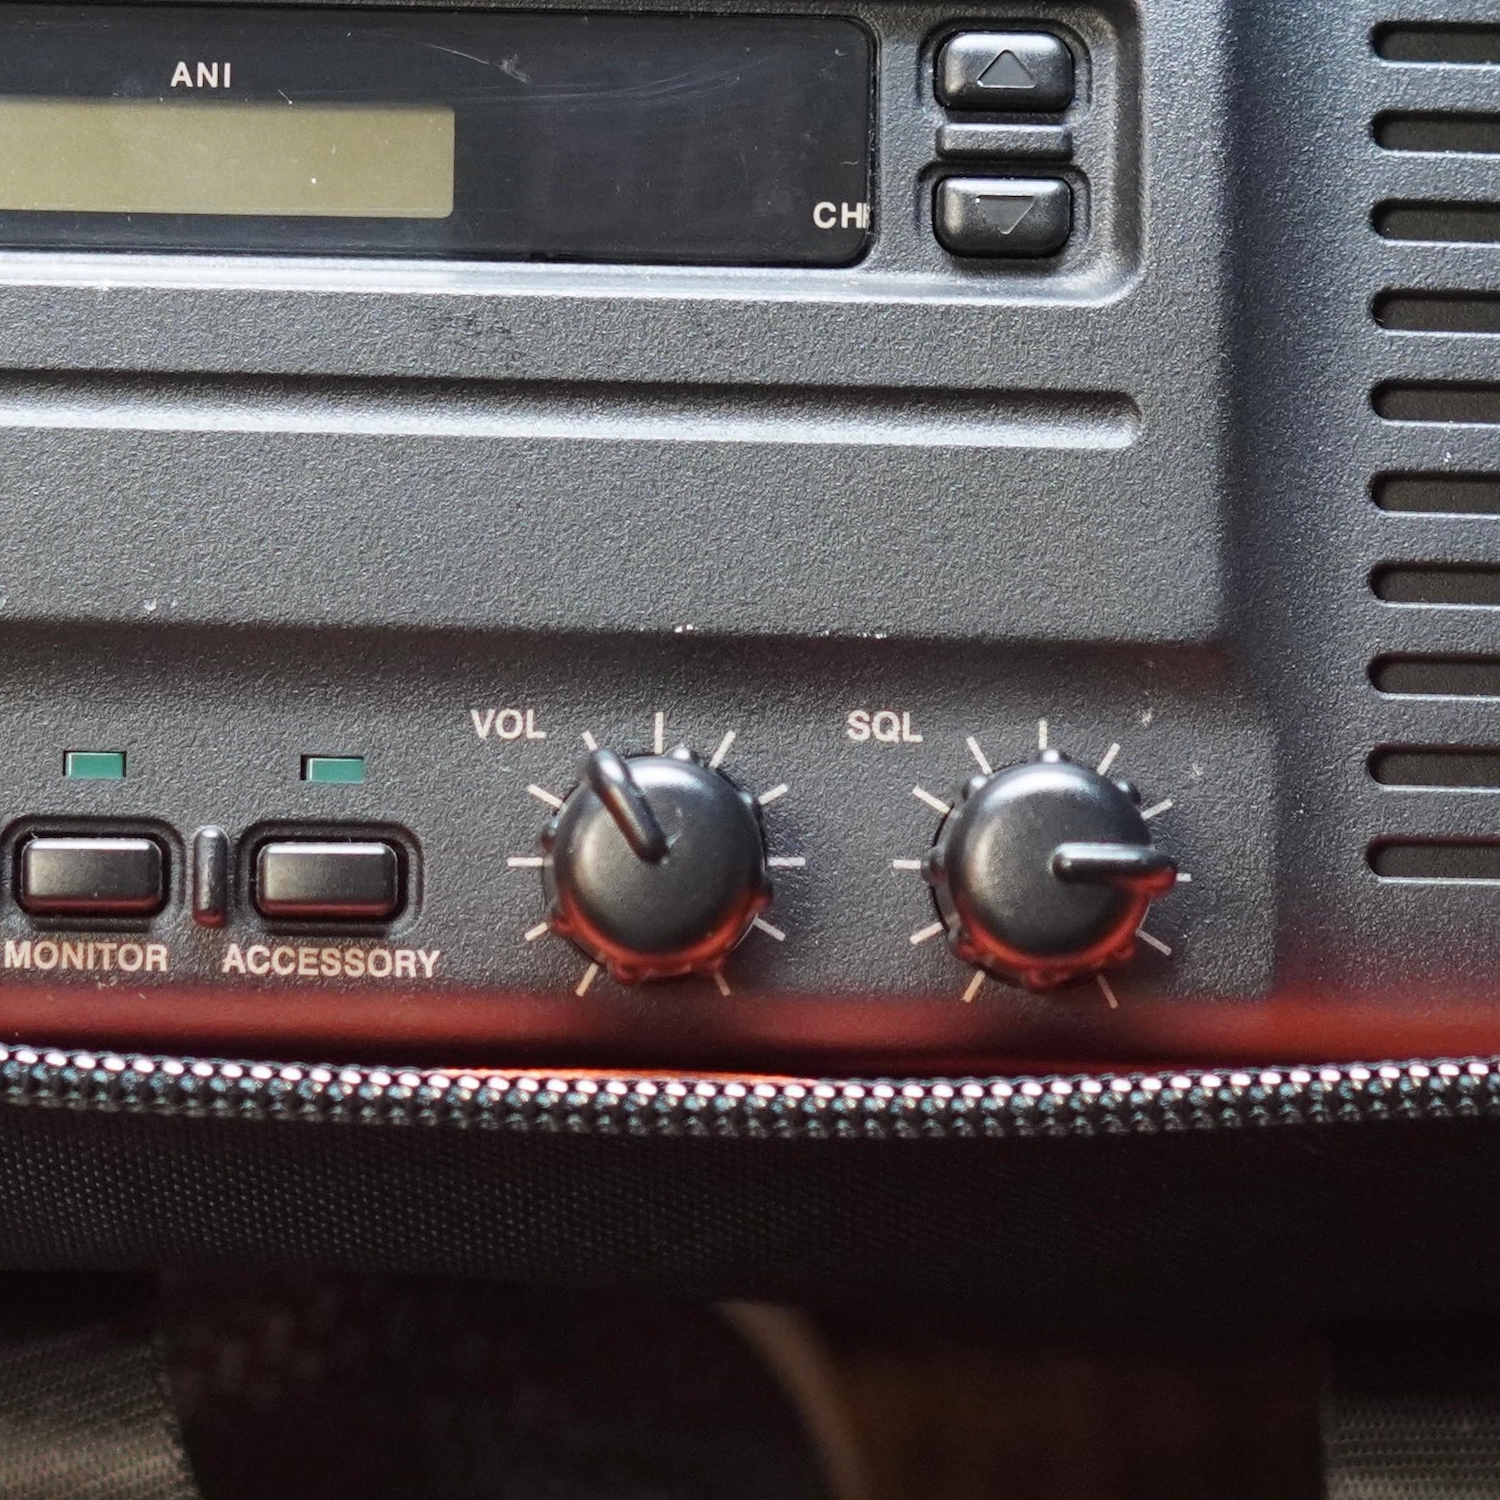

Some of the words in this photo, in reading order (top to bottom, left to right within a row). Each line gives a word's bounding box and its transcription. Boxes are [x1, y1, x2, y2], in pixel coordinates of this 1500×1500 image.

[170, 62, 231, 89] ANI
[470, 708, 547, 739] VOL
[846, 711, 923, 743] SQL
[3, 941, 169, 974] MONITOR
[222, 944, 440, 980] ACCESSORY
